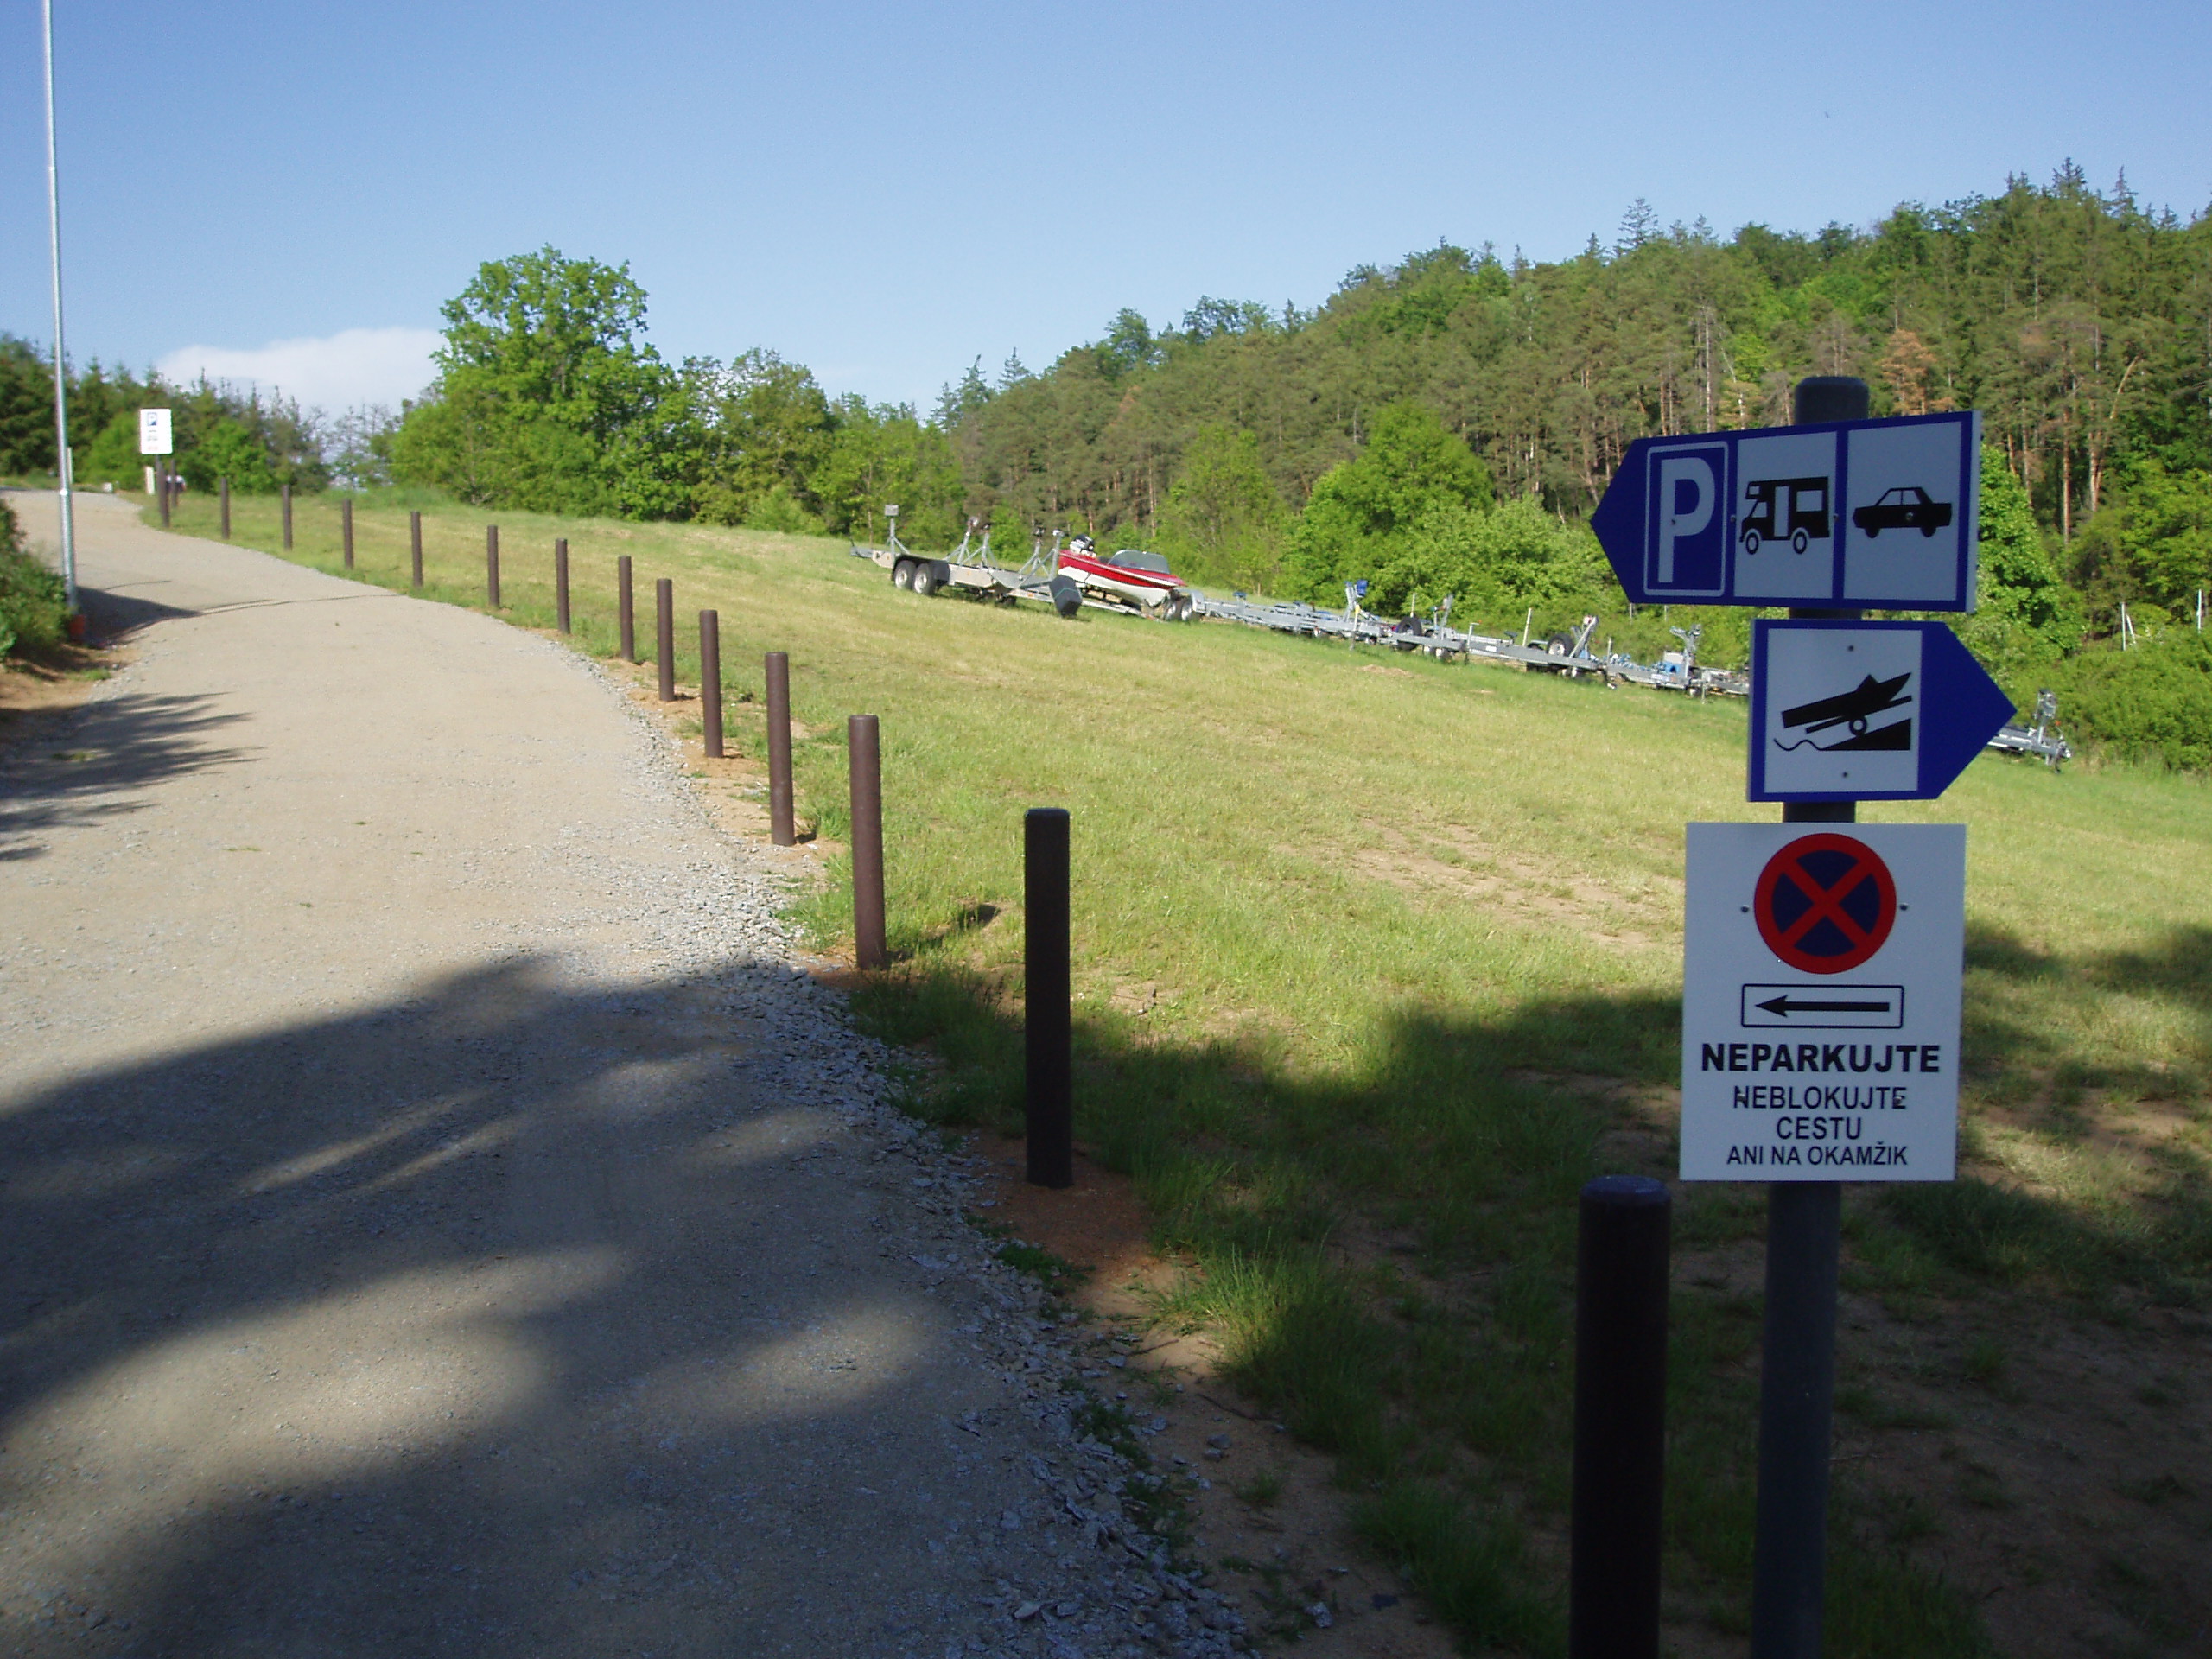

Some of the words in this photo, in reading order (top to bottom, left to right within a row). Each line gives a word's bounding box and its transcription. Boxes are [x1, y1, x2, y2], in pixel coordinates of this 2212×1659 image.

[1658, 457, 1715, 583] P
[1701, 1043, 1941, 1073] NEPARKUJTE
[1733, 1085, 1907, 1110] NEBLOKUJTE
[1777, 1116, 1862, 1140] CESTU
[1727, 1146, 1764, 1165] ANI
[1771, 1146, 1802, 1165] NA
[1808, 1141, 1908, 1166] OKAMŽIK
